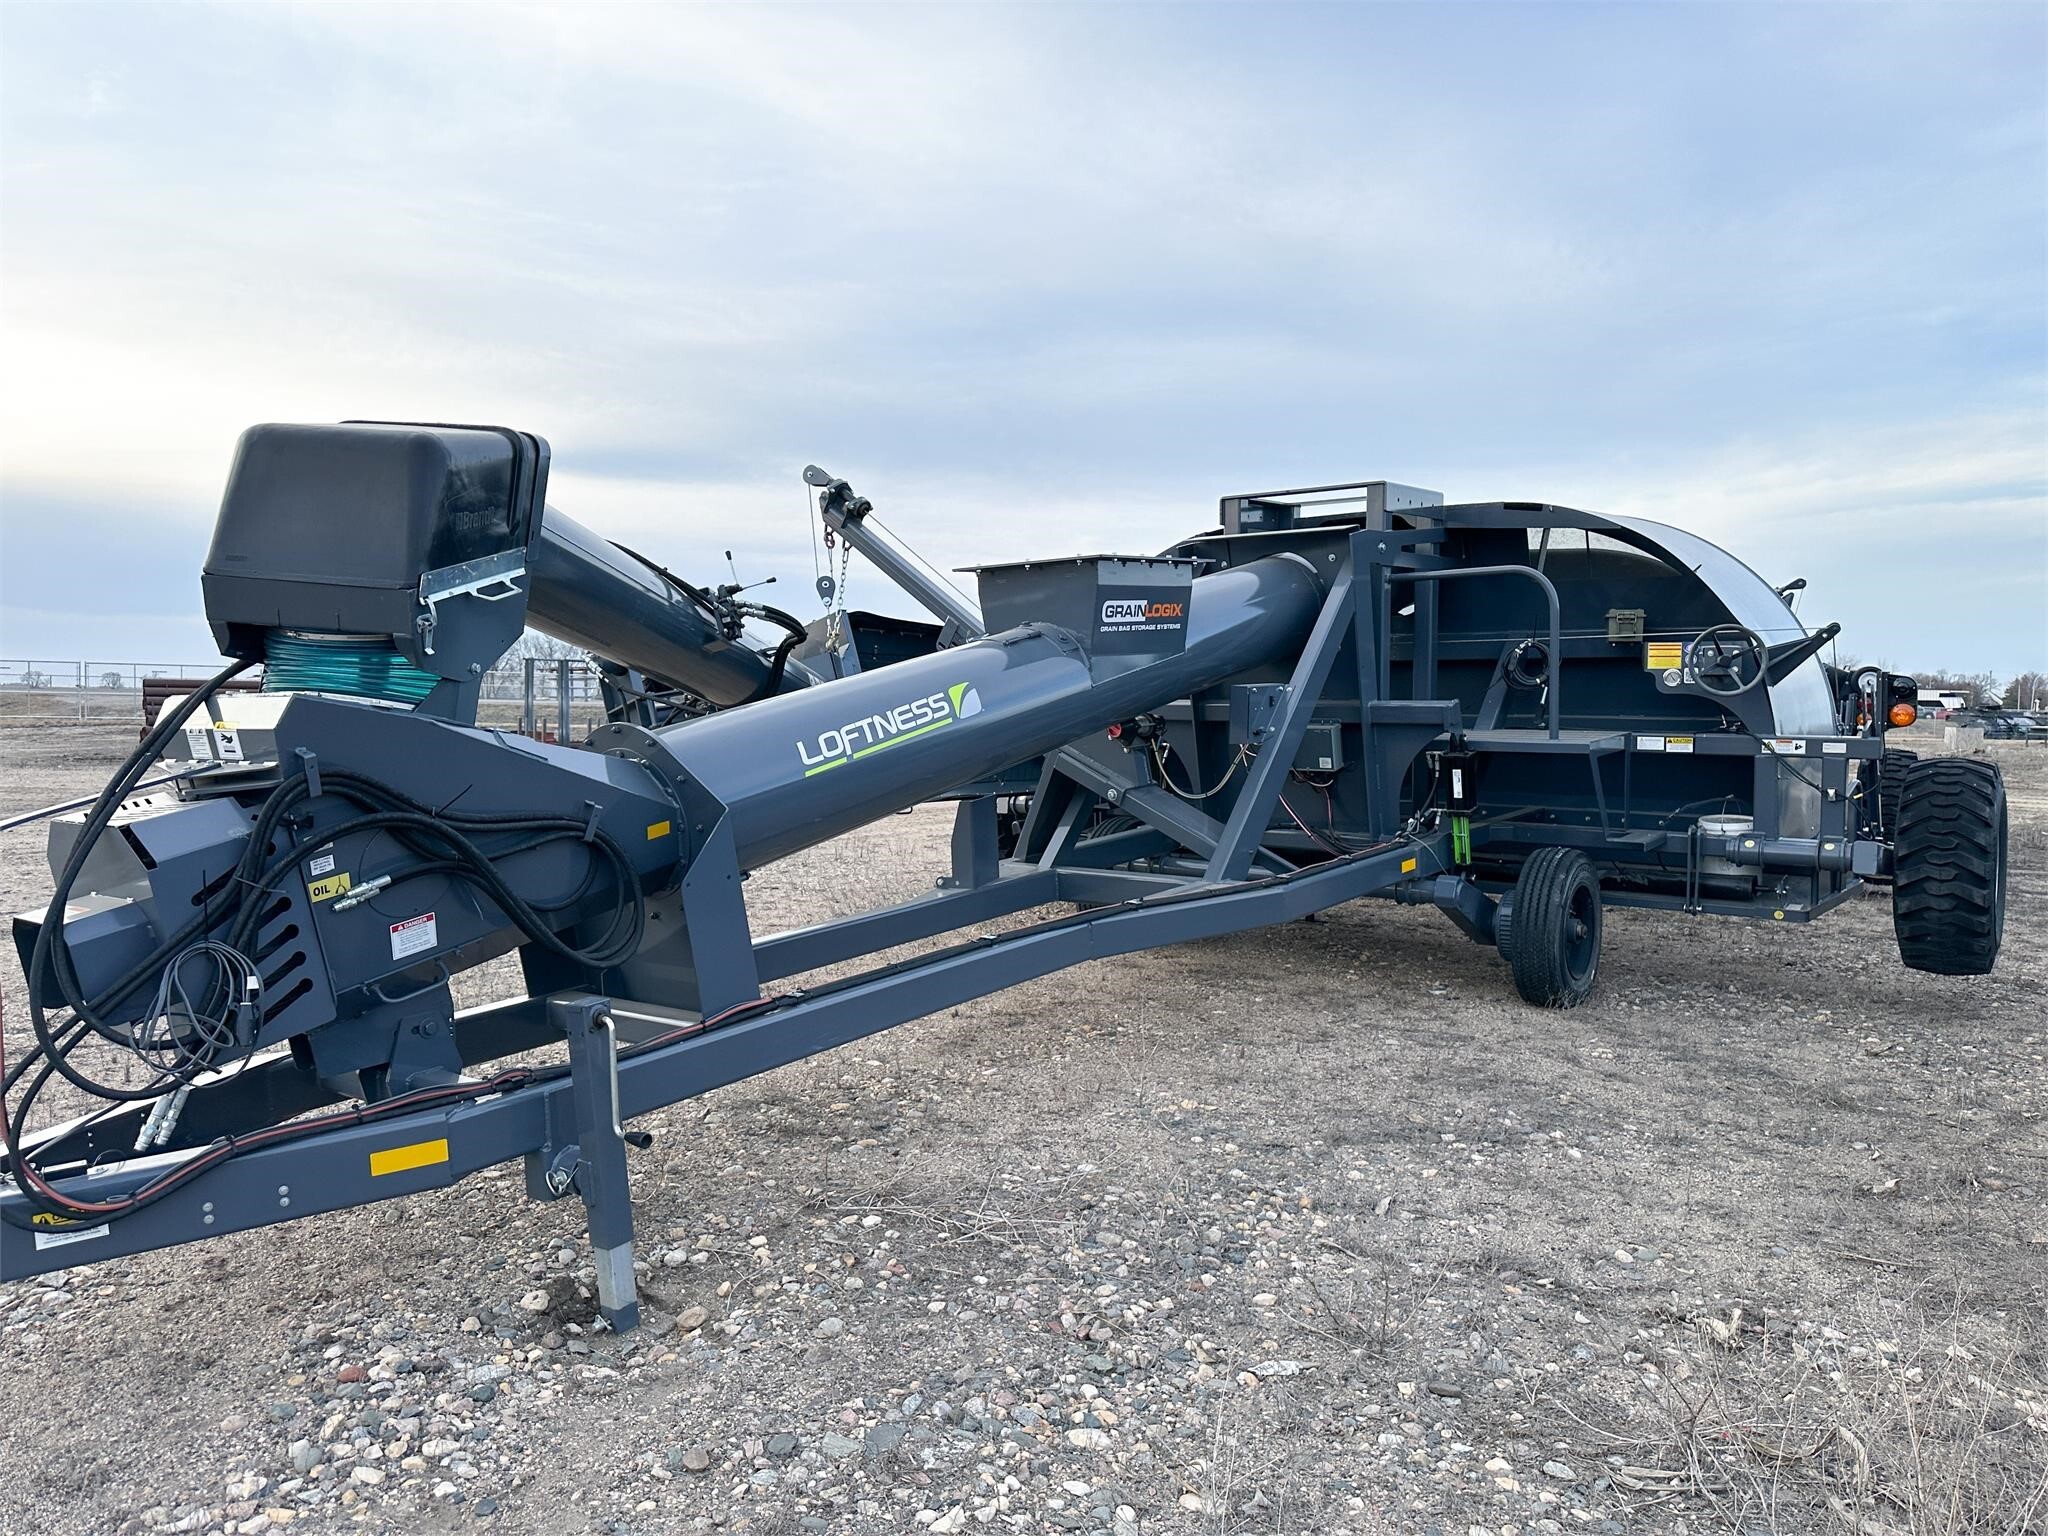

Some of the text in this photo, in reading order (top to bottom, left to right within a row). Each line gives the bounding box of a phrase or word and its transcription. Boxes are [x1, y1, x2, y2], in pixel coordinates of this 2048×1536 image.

[1105, 604, 1182, 618] GRAINLOGIX
[796, 692, 950, 765] LOFTNESS
[313, 885, 330, 897] OIL
[404, 916, 428, 929] DANGER
